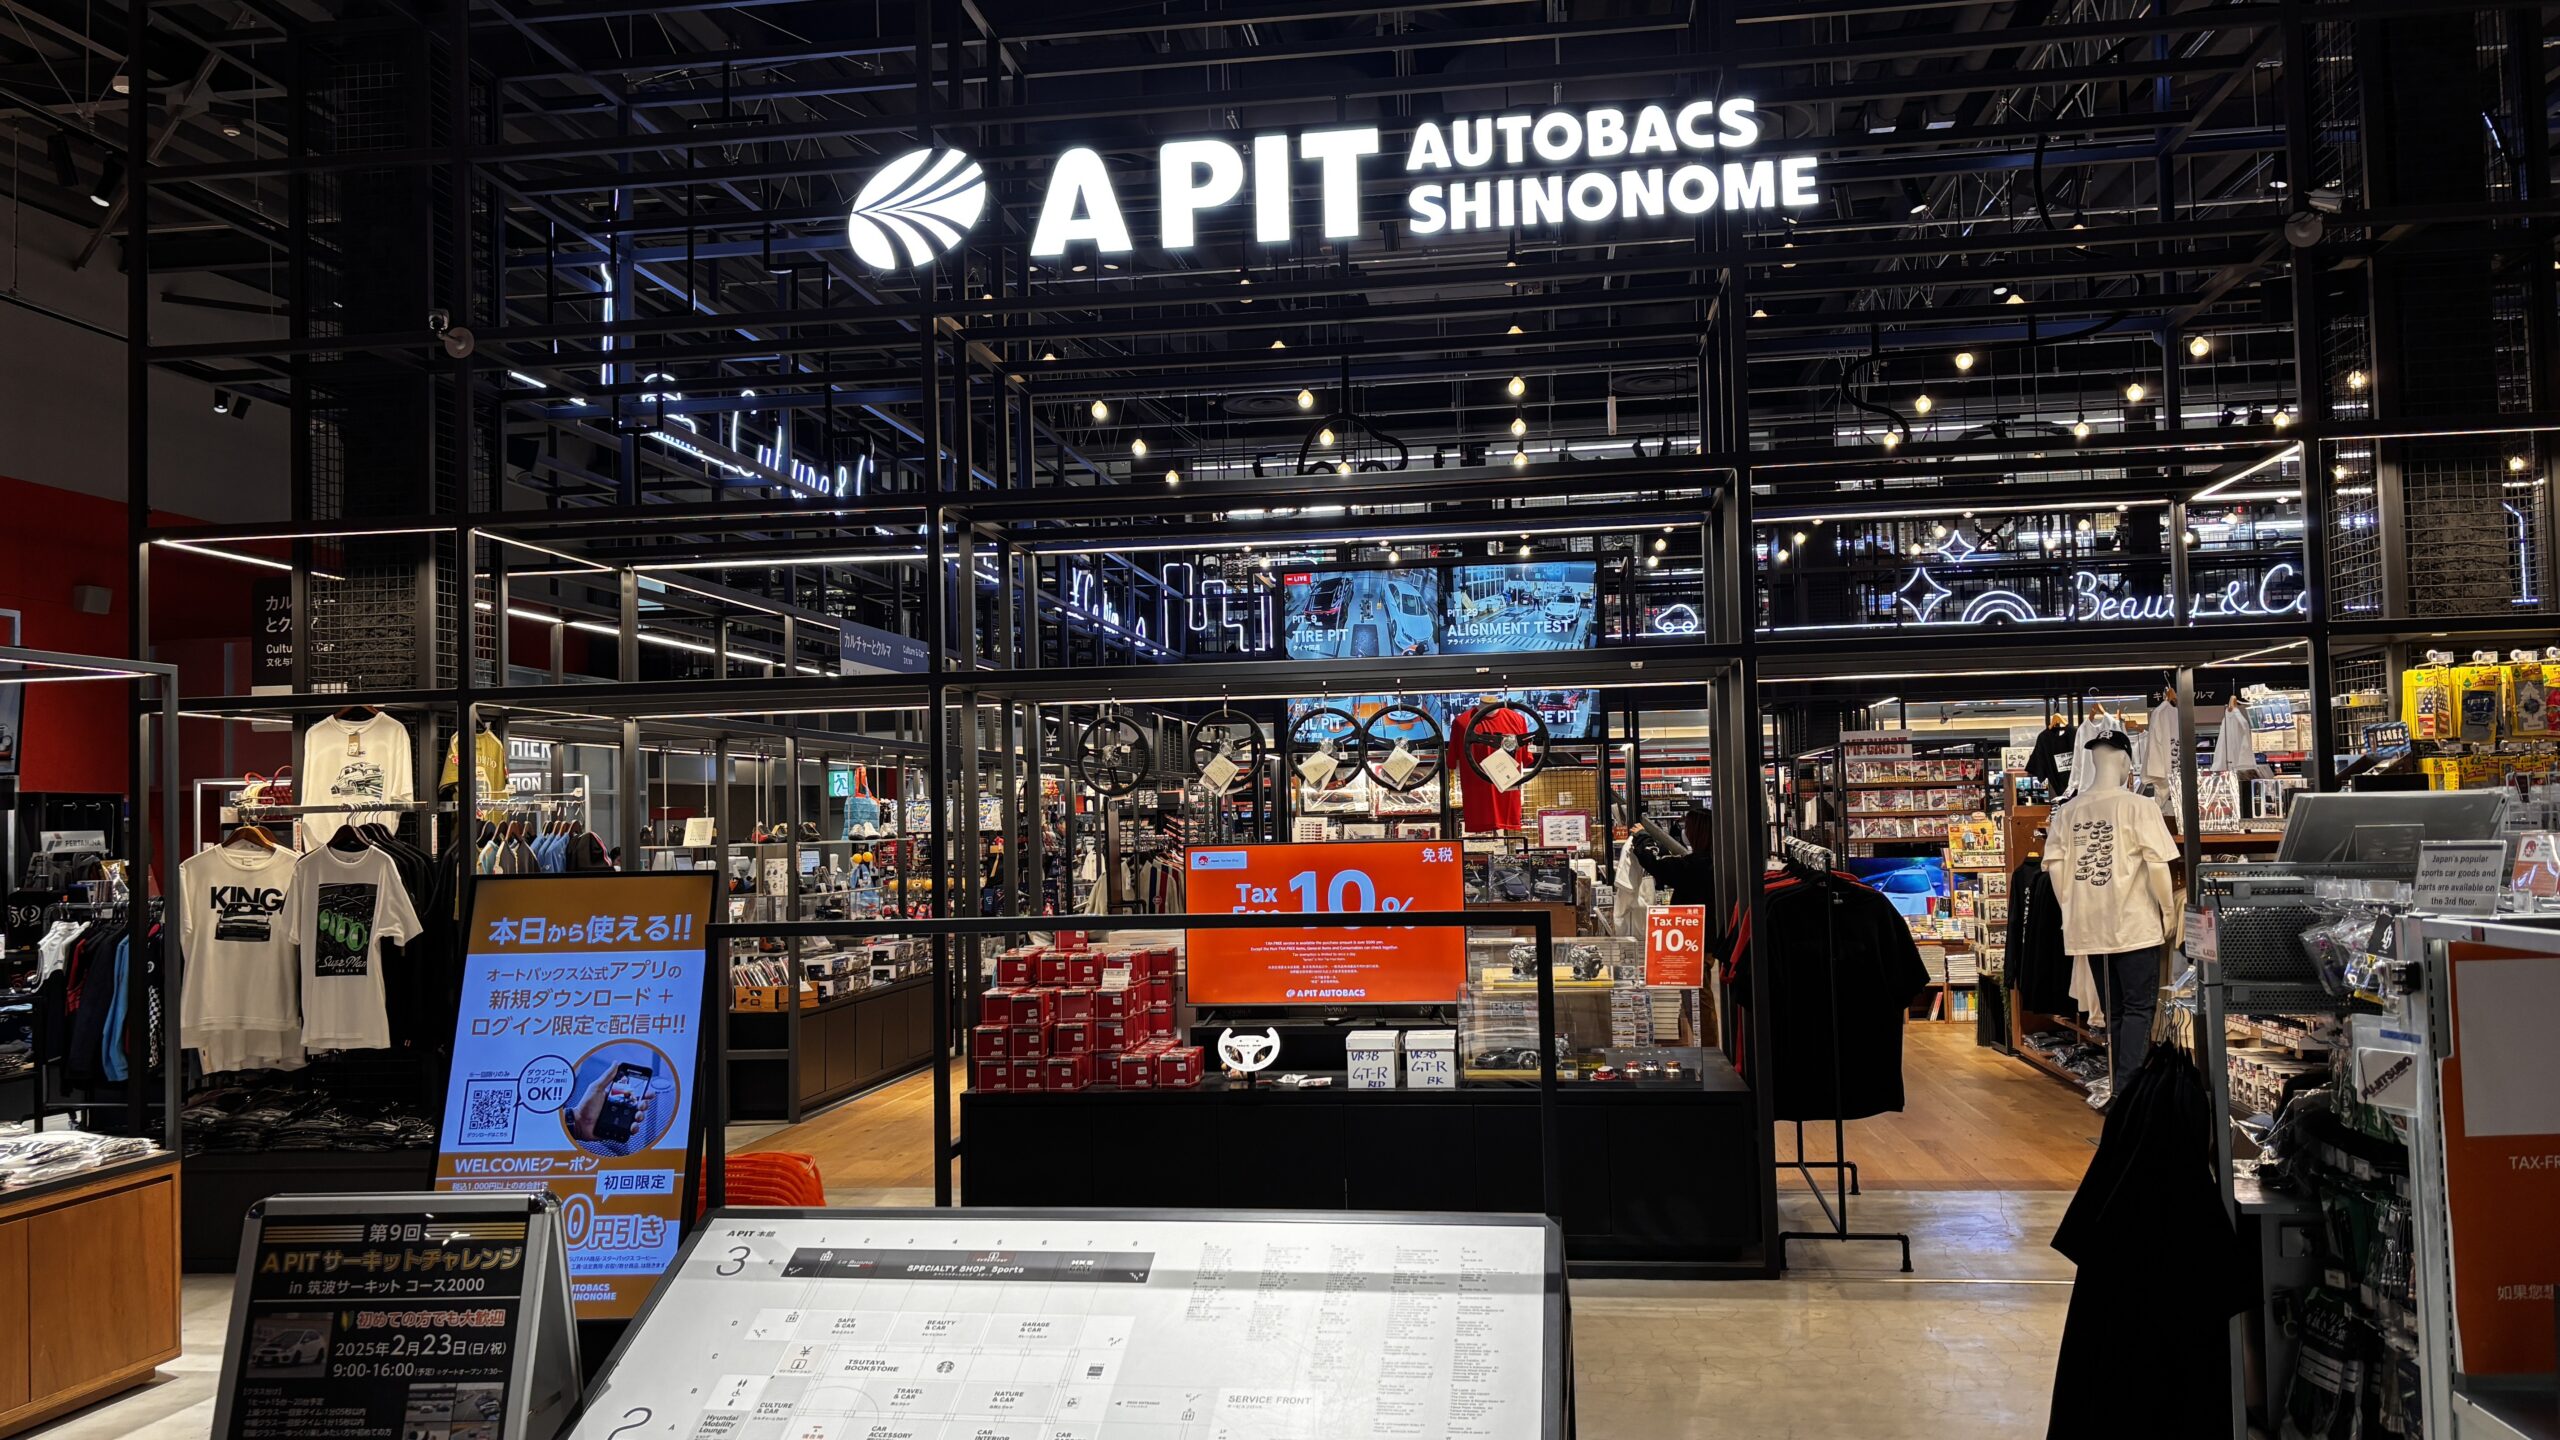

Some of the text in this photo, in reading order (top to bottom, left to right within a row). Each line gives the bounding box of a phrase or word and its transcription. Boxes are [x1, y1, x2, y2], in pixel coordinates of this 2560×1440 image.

[1405, 98, 1759, 171] AUTOBACS
[1030, 127, 1379, 258] A PIT
[1407, 156, 1820, 234] SHINONOME
[2221, 580, 2249, 615] &
[1292, 629, 1348, 643] TIRE PIT
[1447, 620, 1571, 637] ALIGNMENT TEST
[844, 632, 892, 658] カルチャーとクルマ
[1321, 717, 1342, 730] PIT
[1557, 710, 1580, 723] PIT
[1422, 847, 1453, 863] 免税
[2432, 854, 2489, 864] Japan's popular
[2421, 869, 2443, 878] sports
[2457, 868, 2480, 878] goods
[2481, 869, 2496, 877] and
[1236, 884, 1277, 903] Tax
[2418, 884, 2436, 892] parts
[2451, 883, 2484, 891] available
[2431, 897, 2477, 906] the 3rd floor.
[488, 913, 692, 945] 本日から使える!!
[1652, 916, 1699, 926] Tax Free
[1651, 928, 1699, 952] 10%
[486, 959, 682, 982] オートバックス公式アプリの
[489, 987, 651, 1010] 新規ダウンロード
[1297, 988, 1366, 997] A PIT AUTOBACS
[470, 1013, 686, 1036] ログイン限定で配信中!!
[527, 1068, 568, 1076] ダウンロード
[1352, 1066, 1388, 1080] GT-R
[1411, 1061, 1448, 1072] GT-R
[1368, 1080, 1386, 1088] RED
[1427, 1076, 1444, 1085] BK
[527, 1086, 563, 1101] OK!!
[454, 1156, 600, 1173] WELCOMEクーポン
[604, 1175, 666, 1190] 初回限定
[369, 1223, 422, 1243] 第9回
[716, 1246, 751, 1276] 3
[991, 1266, 1024, 1274] Sports
[289, 1278, 485, 1295] in 筑波サーキット コース2000
[357, 1309, 506, 1330] 初めての方でも大歓迎
[335, 1334, 507, 1357] 2025年2月23日(日/祝)
[1228, 1395, 1312, 1405] SERVICE FRONT
[607, 1407, 652, 1440] 2
